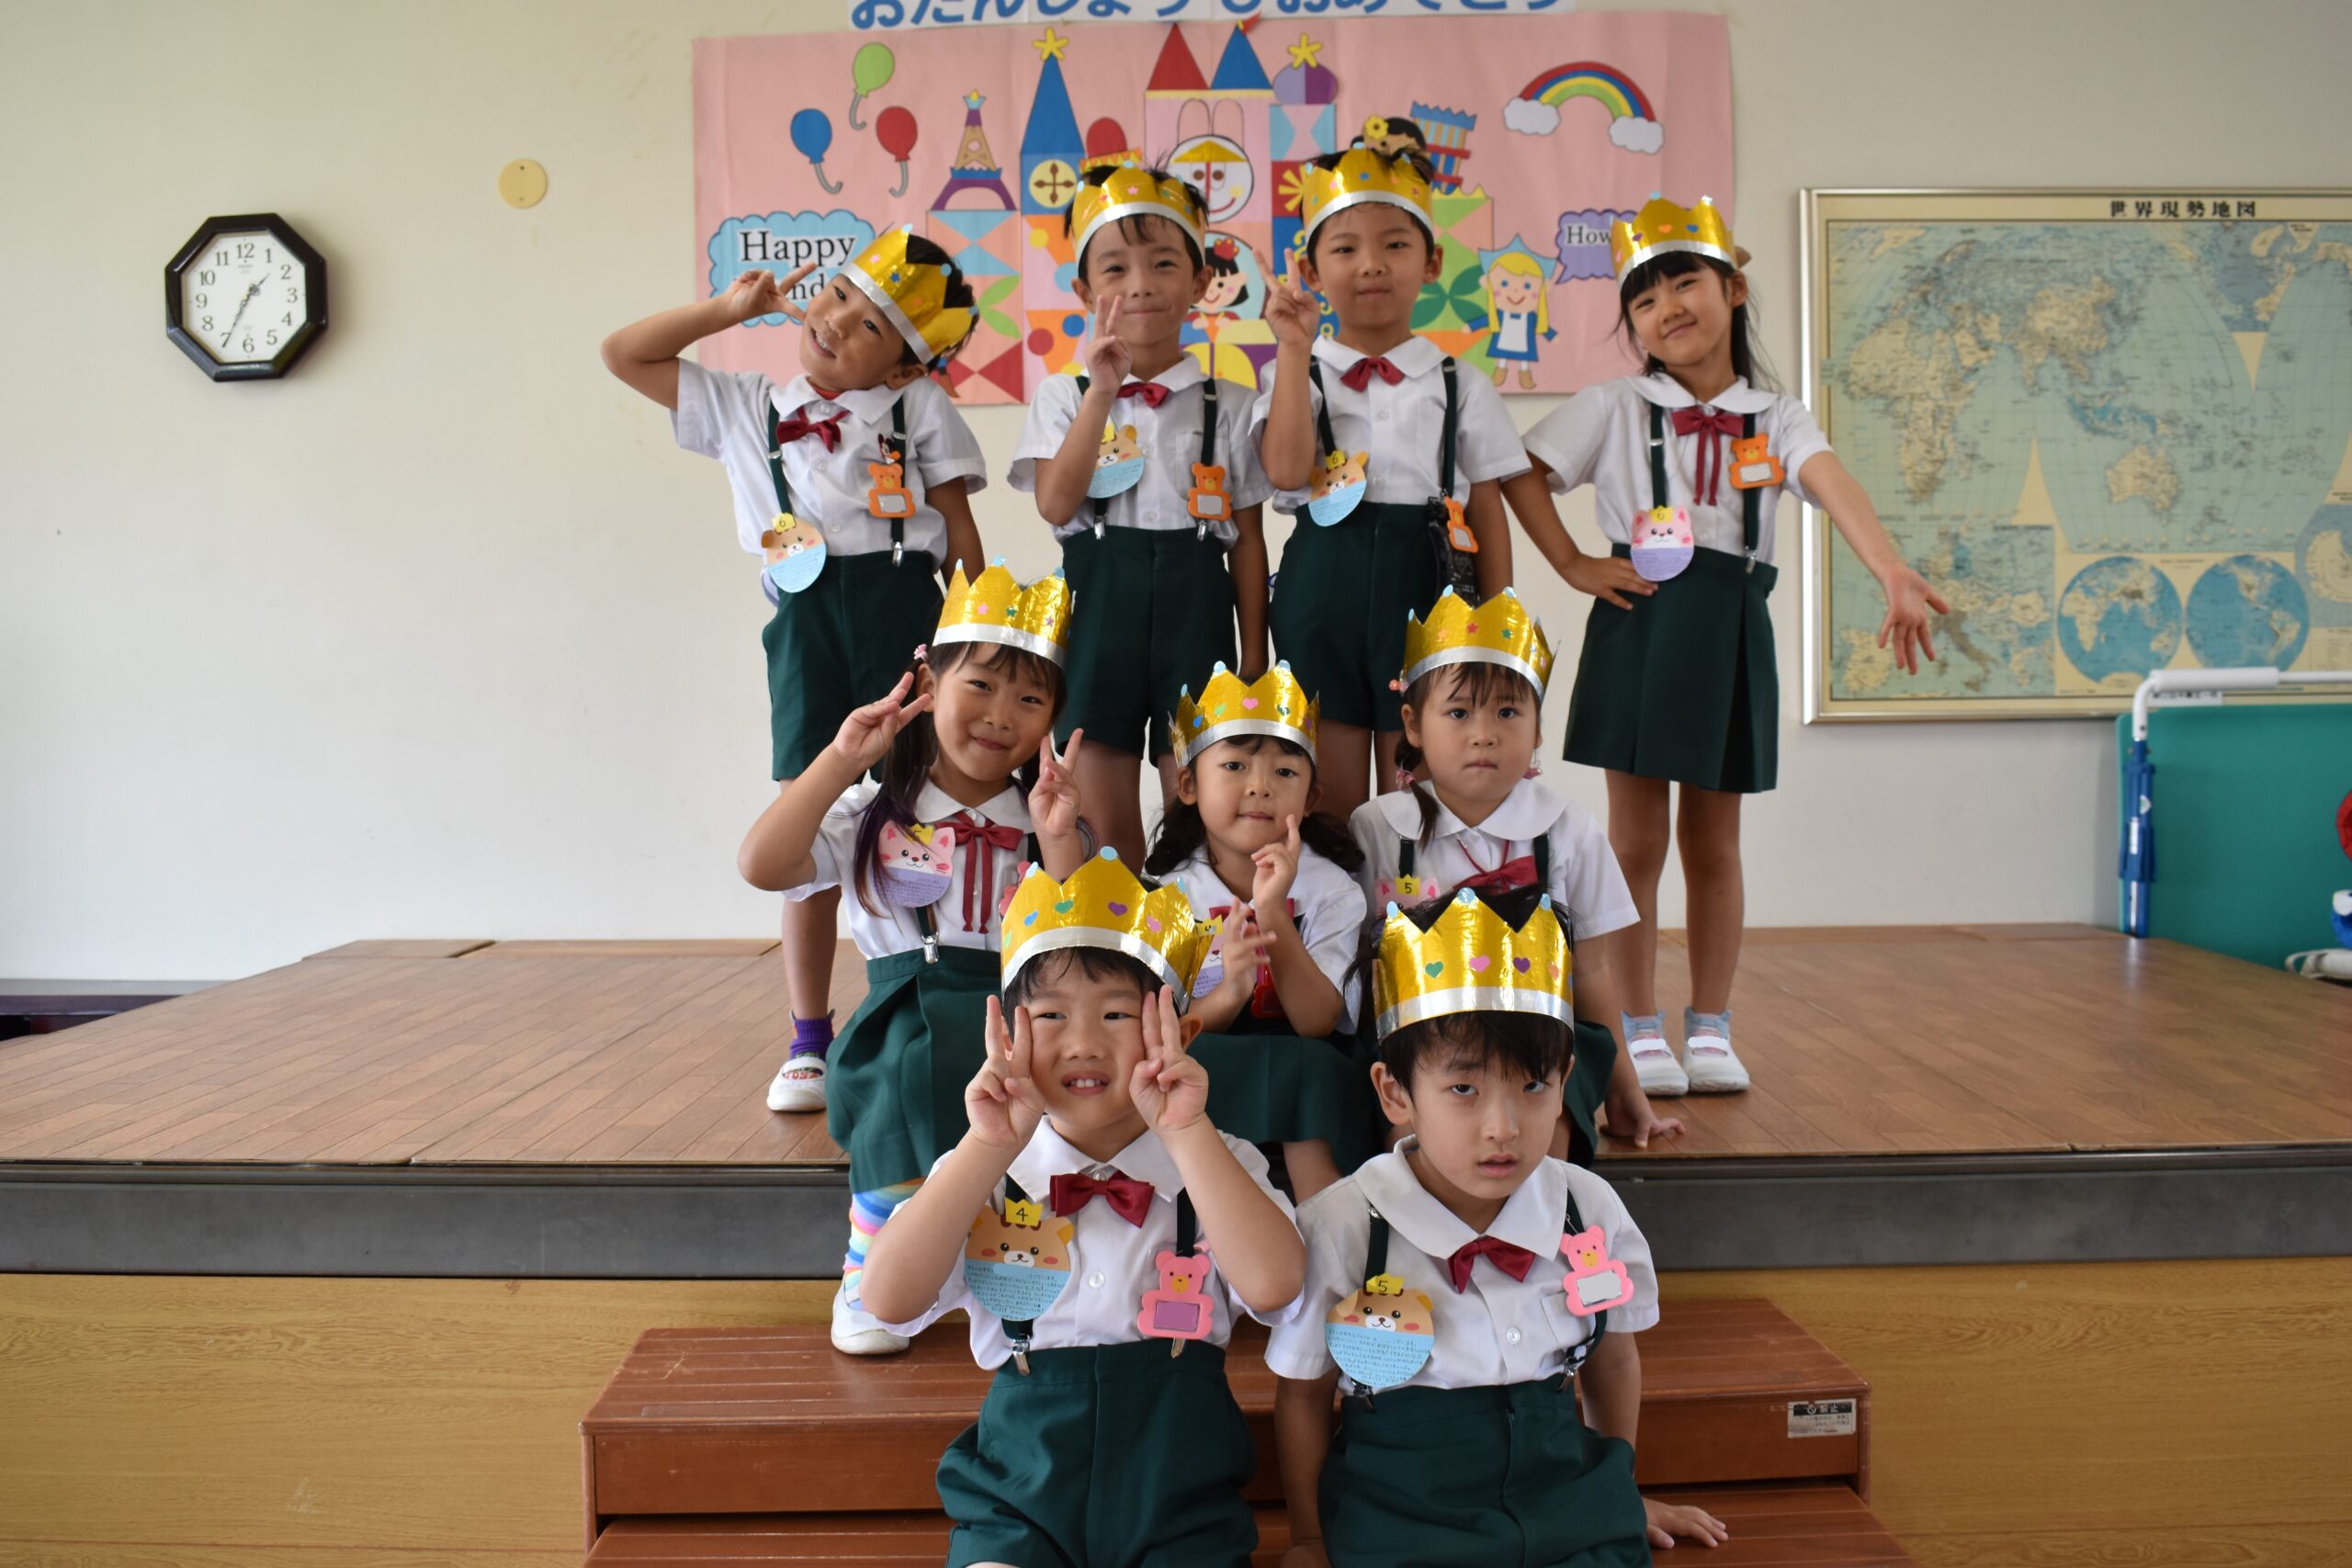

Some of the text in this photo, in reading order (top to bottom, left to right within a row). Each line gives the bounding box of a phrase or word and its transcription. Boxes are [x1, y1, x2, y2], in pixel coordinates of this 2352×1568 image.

[2110, 200, 2256, 218] 世界現勢地図
[1566, 225, 1611, 243] How
[236, 243, 254, 259] 12
[265, 248, 273, 263] 1
[741, 231, 855, 267] Happy
[215, 251, 230, 266] 11
[199, 270, 216, 286] 10
[280, 264, 291, 280] 2
[196, 293, 208, 309] 9
[287, 288, 298, 303] 3
[202, 316, 214, 332] 8
[281, 311, 292, 326] 4
[220, 333, 232, 348] 7
[243, 337, 254, 353] 6
[266, 330, 277, 345] 5
[1404, 882, 1412, 894] 5
[1016, 1207, 1029, 1222] 4
[1378, 1280, 1389, 1293] 5
